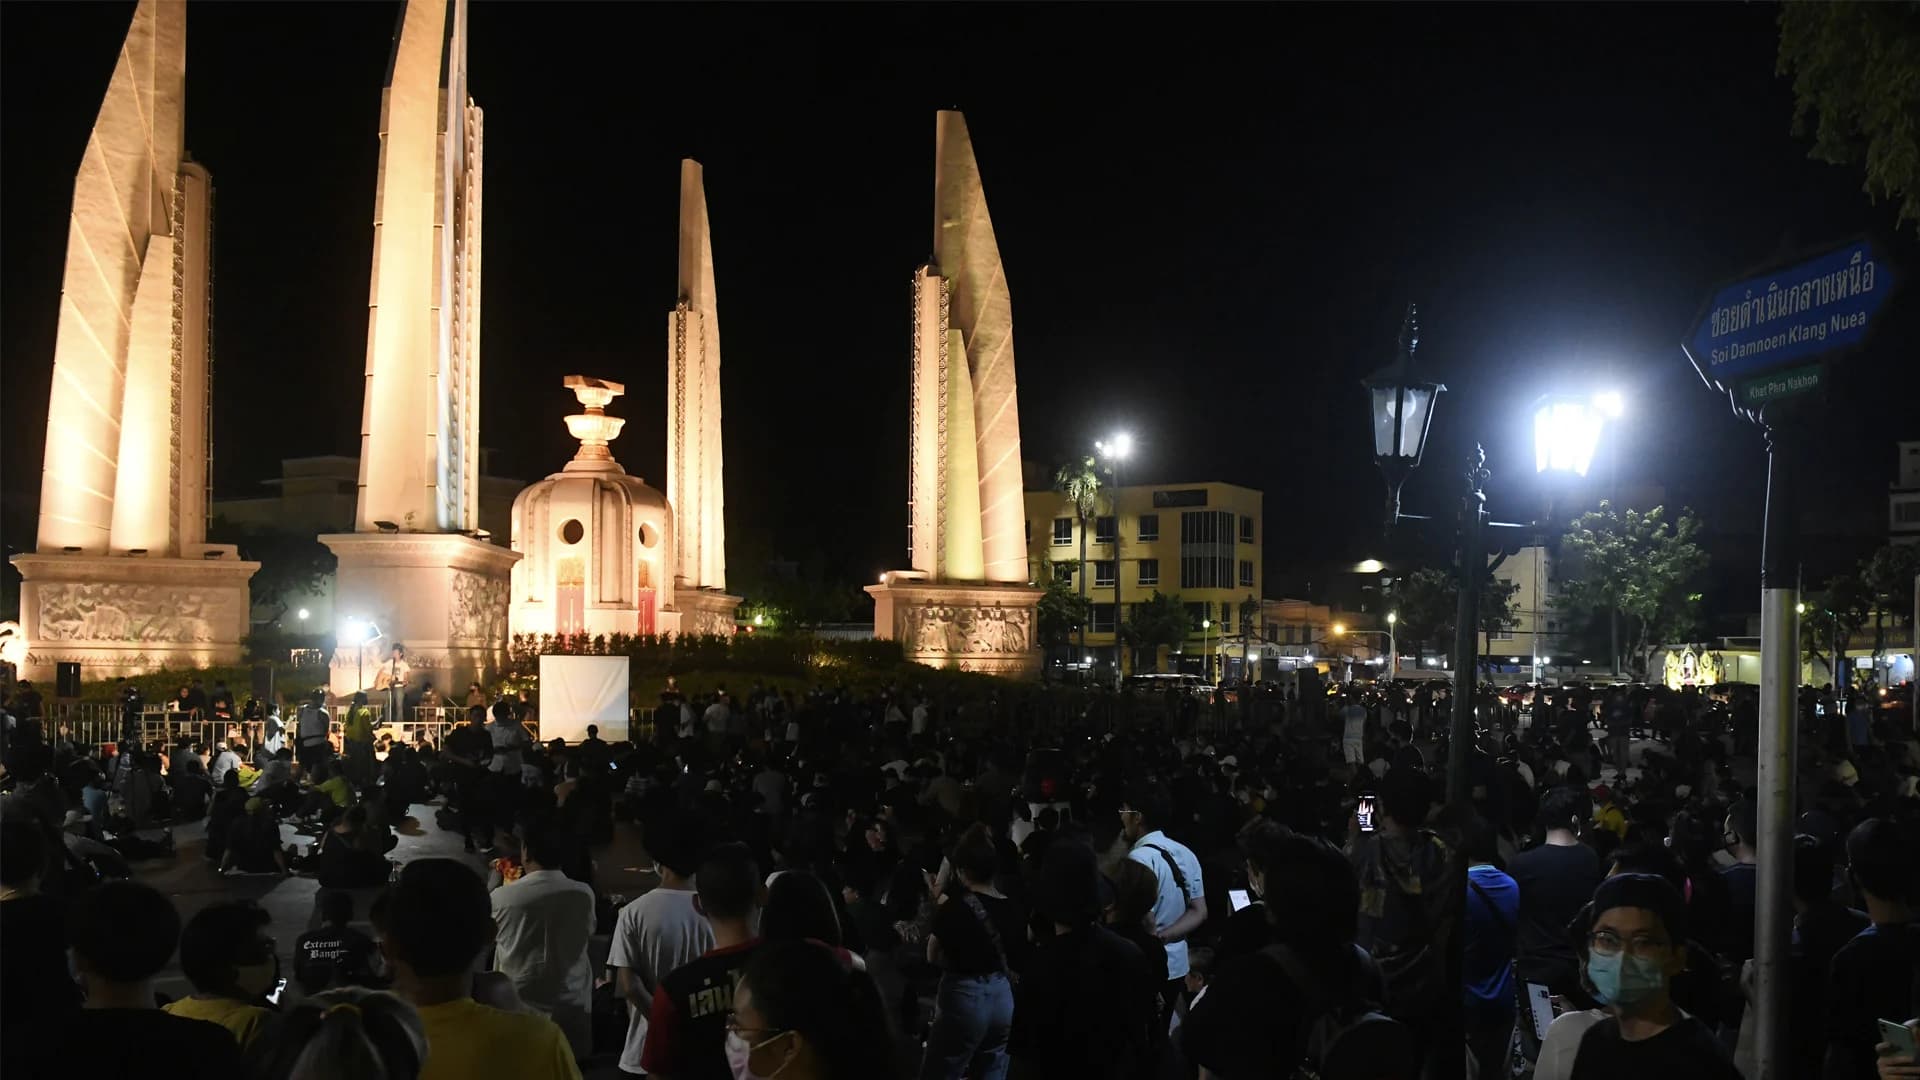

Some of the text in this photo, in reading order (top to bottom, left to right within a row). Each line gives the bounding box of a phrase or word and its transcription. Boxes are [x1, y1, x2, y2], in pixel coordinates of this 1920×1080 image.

[1711, 251, 1875, 338] ซอยดำเนินกลางเหนือ
[1711, 311, 1866, 366] Soi Damnoen Klang Nuea
